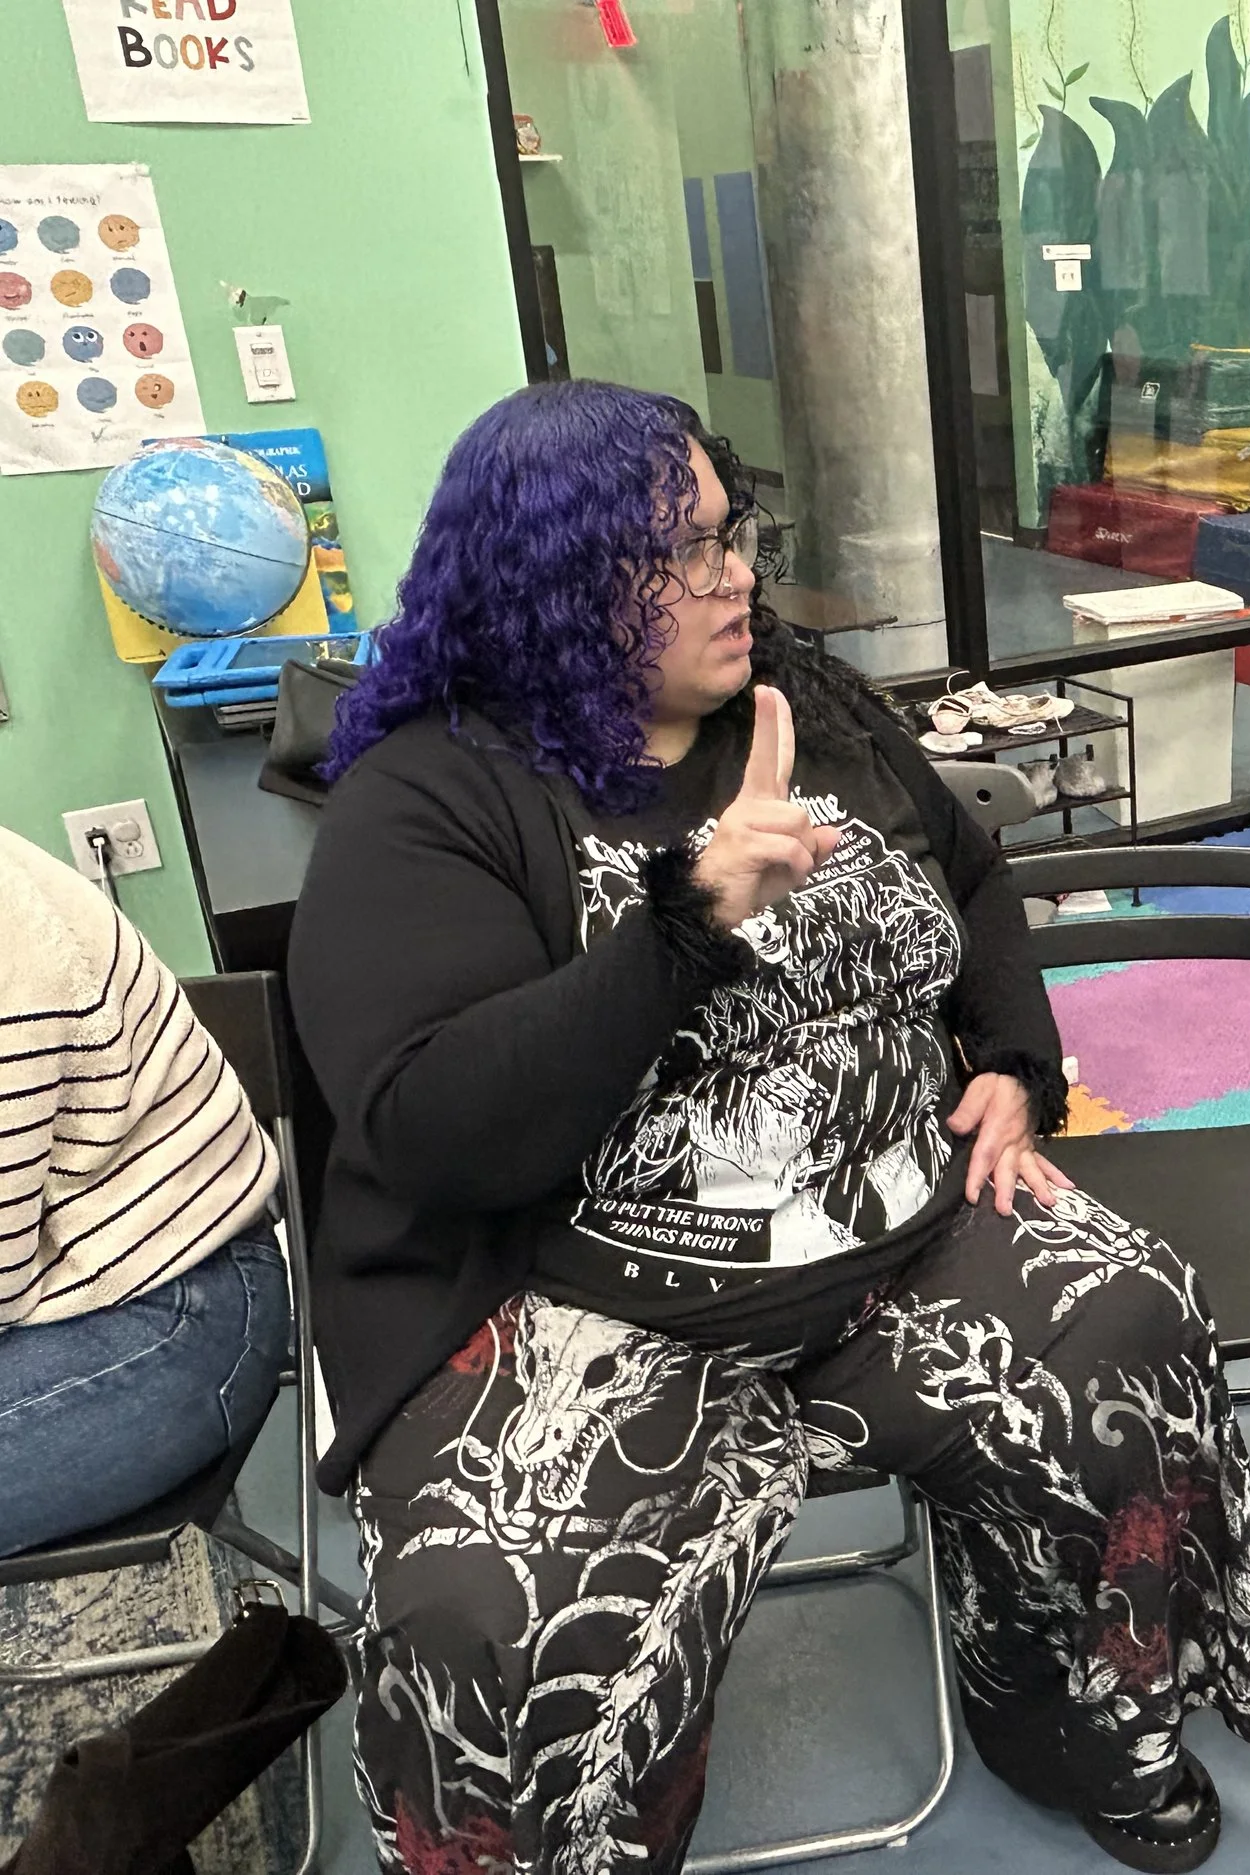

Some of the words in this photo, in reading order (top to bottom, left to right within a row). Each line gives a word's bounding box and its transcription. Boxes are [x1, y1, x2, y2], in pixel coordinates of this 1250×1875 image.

[117, 26, 255, 72] BOOKS
[618, 1201, 656, 1219] PUT
[657, 1206, 695, 1226] THE
[696, 1212, 764, 1232] WRONG
[609, 1220, 678, 1244] THINGS
[678, 1231, 738, 1252] RIGHT
